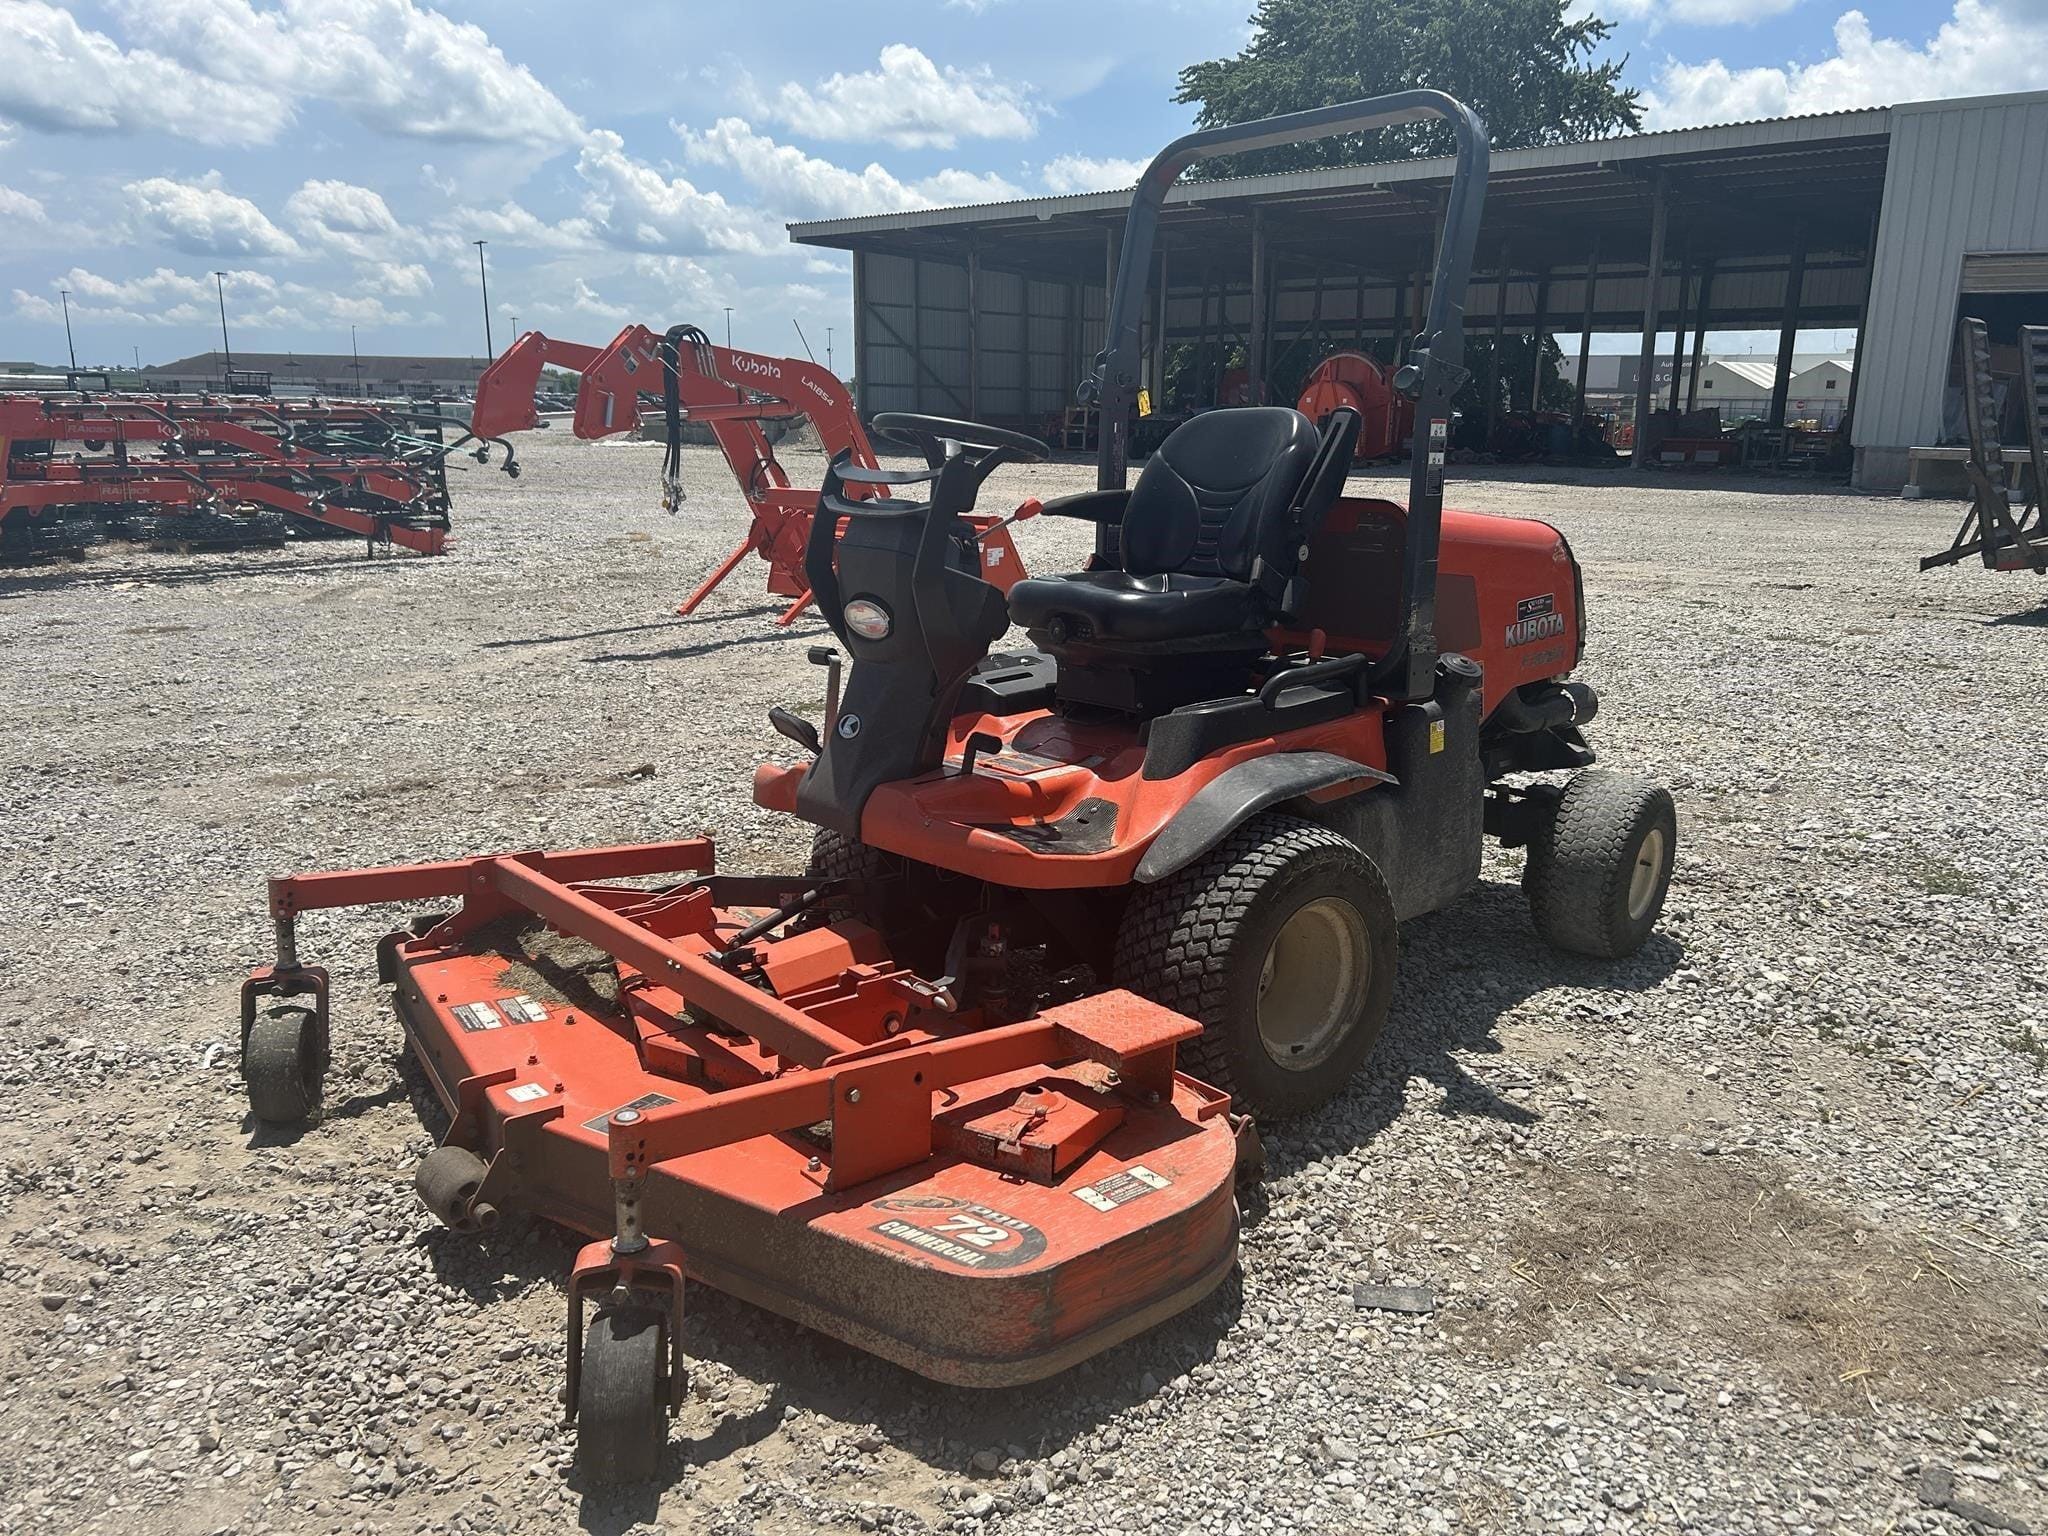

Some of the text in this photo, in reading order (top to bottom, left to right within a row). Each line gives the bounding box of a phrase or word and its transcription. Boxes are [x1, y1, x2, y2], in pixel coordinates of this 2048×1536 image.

[732, 354, 781, 379] Kubota
[801, 375, 835, 407] LA1854
[1505, 613, 1564, 647] KUBOTA
[932, 1214, 1009, 1248] 72
[966, 1205, 1032, 1231] PRO
[878, 1220, 987, 1265] COMMERCIAL
